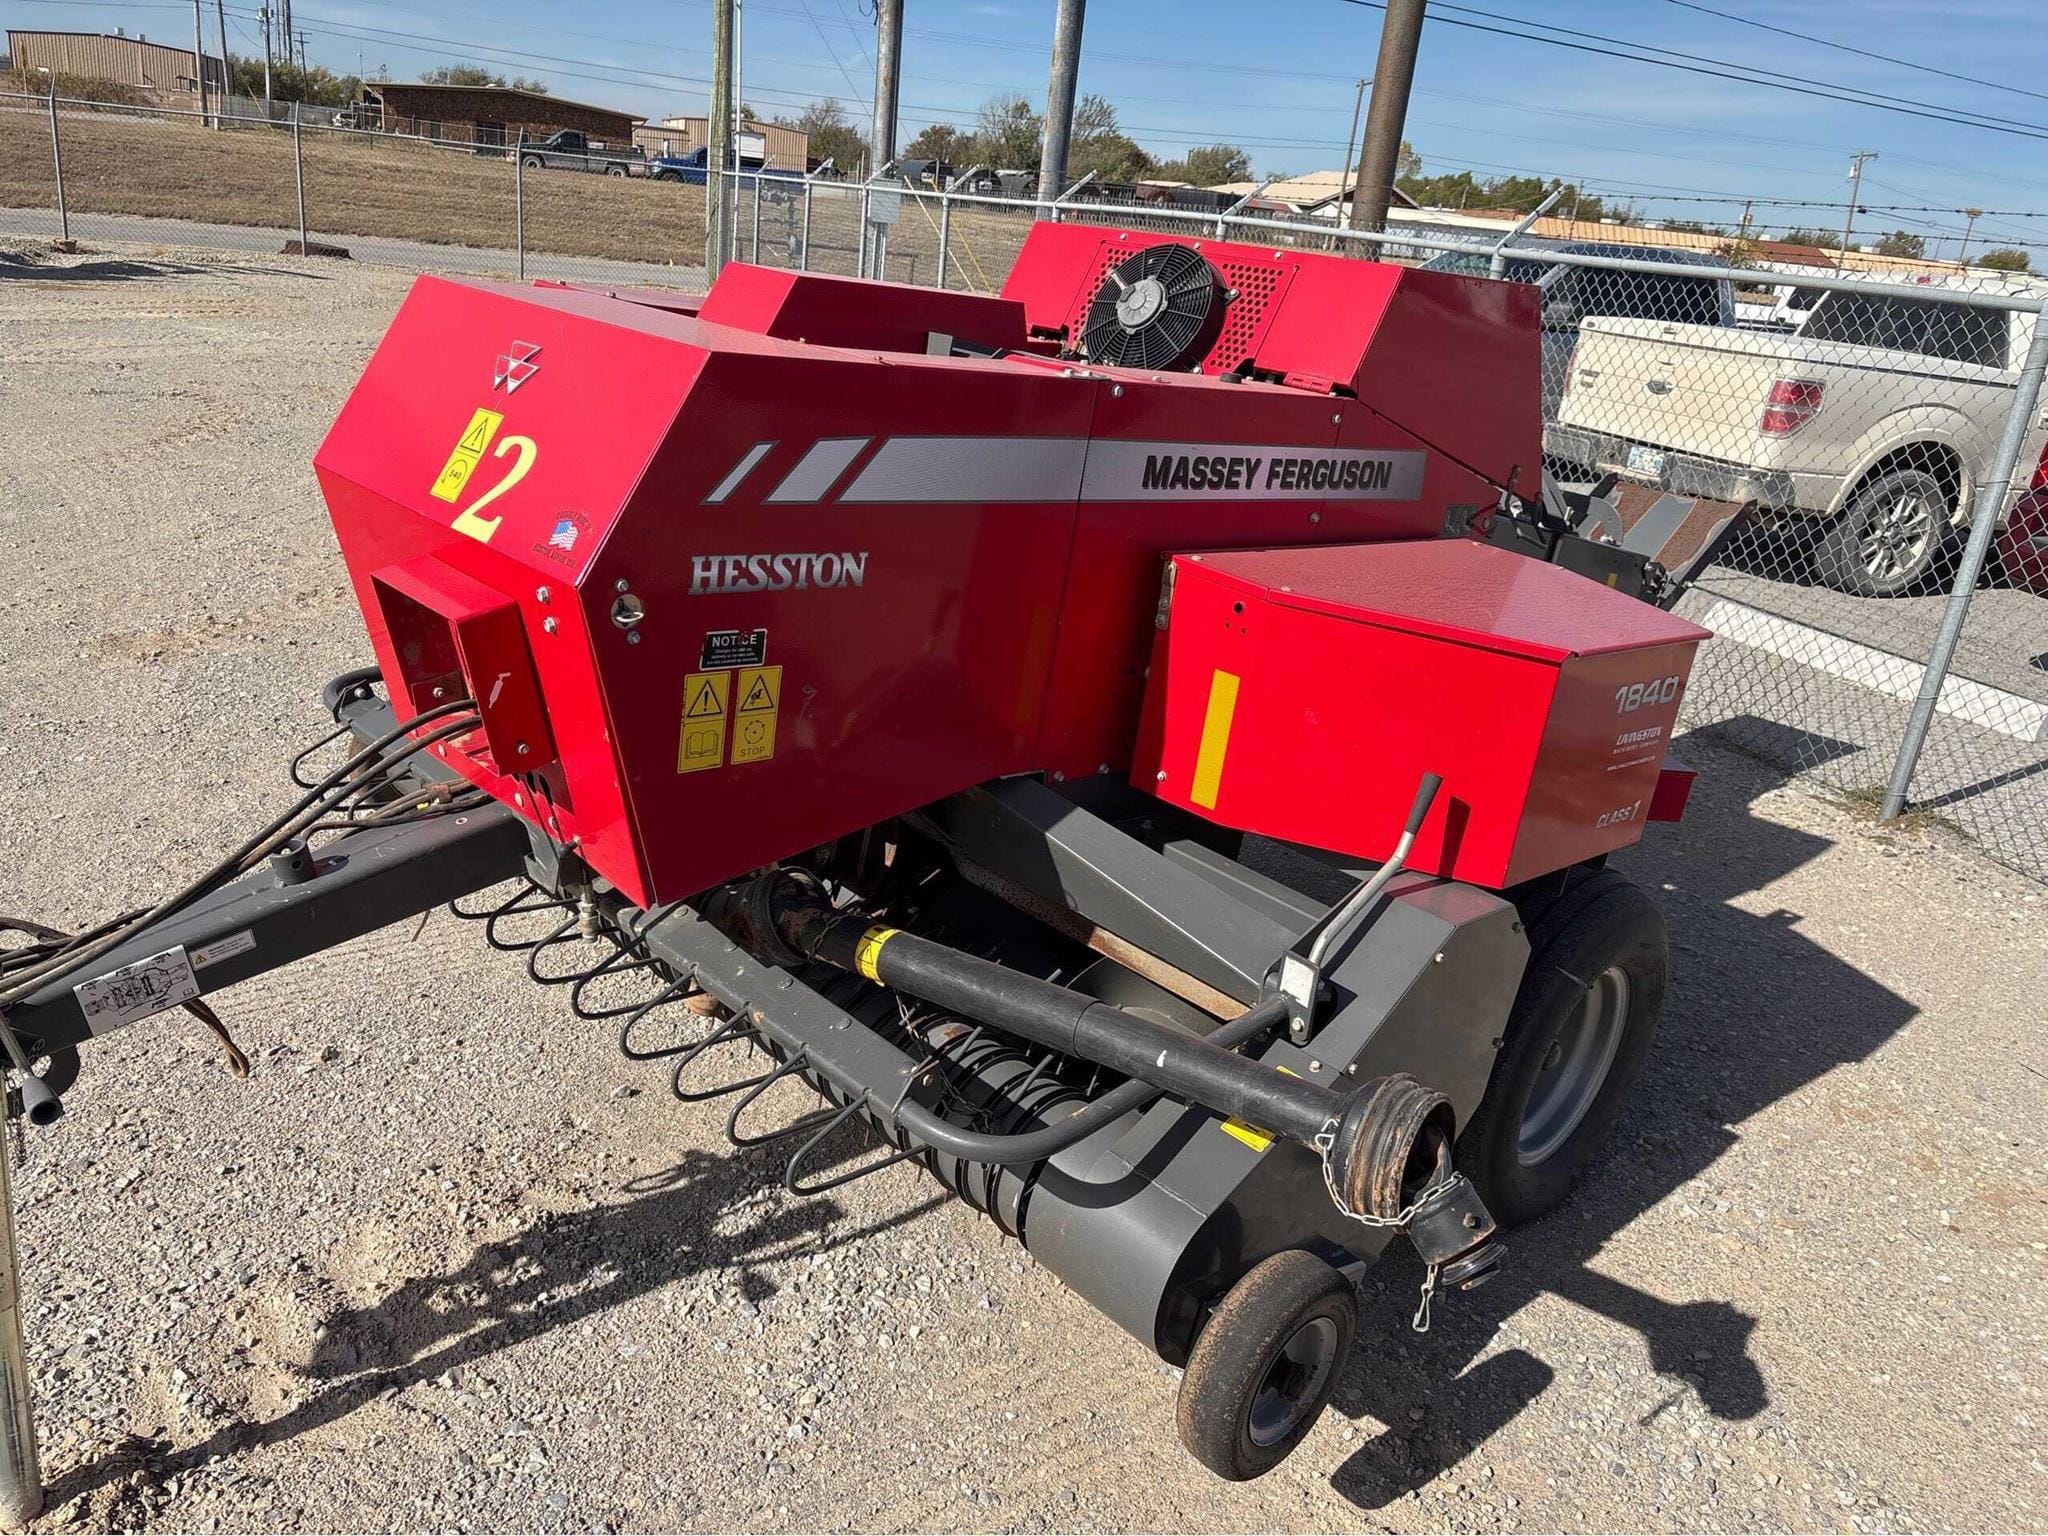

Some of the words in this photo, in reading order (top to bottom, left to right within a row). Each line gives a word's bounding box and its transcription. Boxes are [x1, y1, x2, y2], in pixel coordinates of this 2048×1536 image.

[450, 434, 538, 544] 2
[1141, 454, 1263, 491] MASSEY
[1265, 457, 1393, 491] FERGUSON
[687, 551, 869, 596] HESSTON
[1615, 675, 1680, 714] 1840
[739, 745, 766, 757] STOP
[1596, 806, 1632, 829] CLASS
